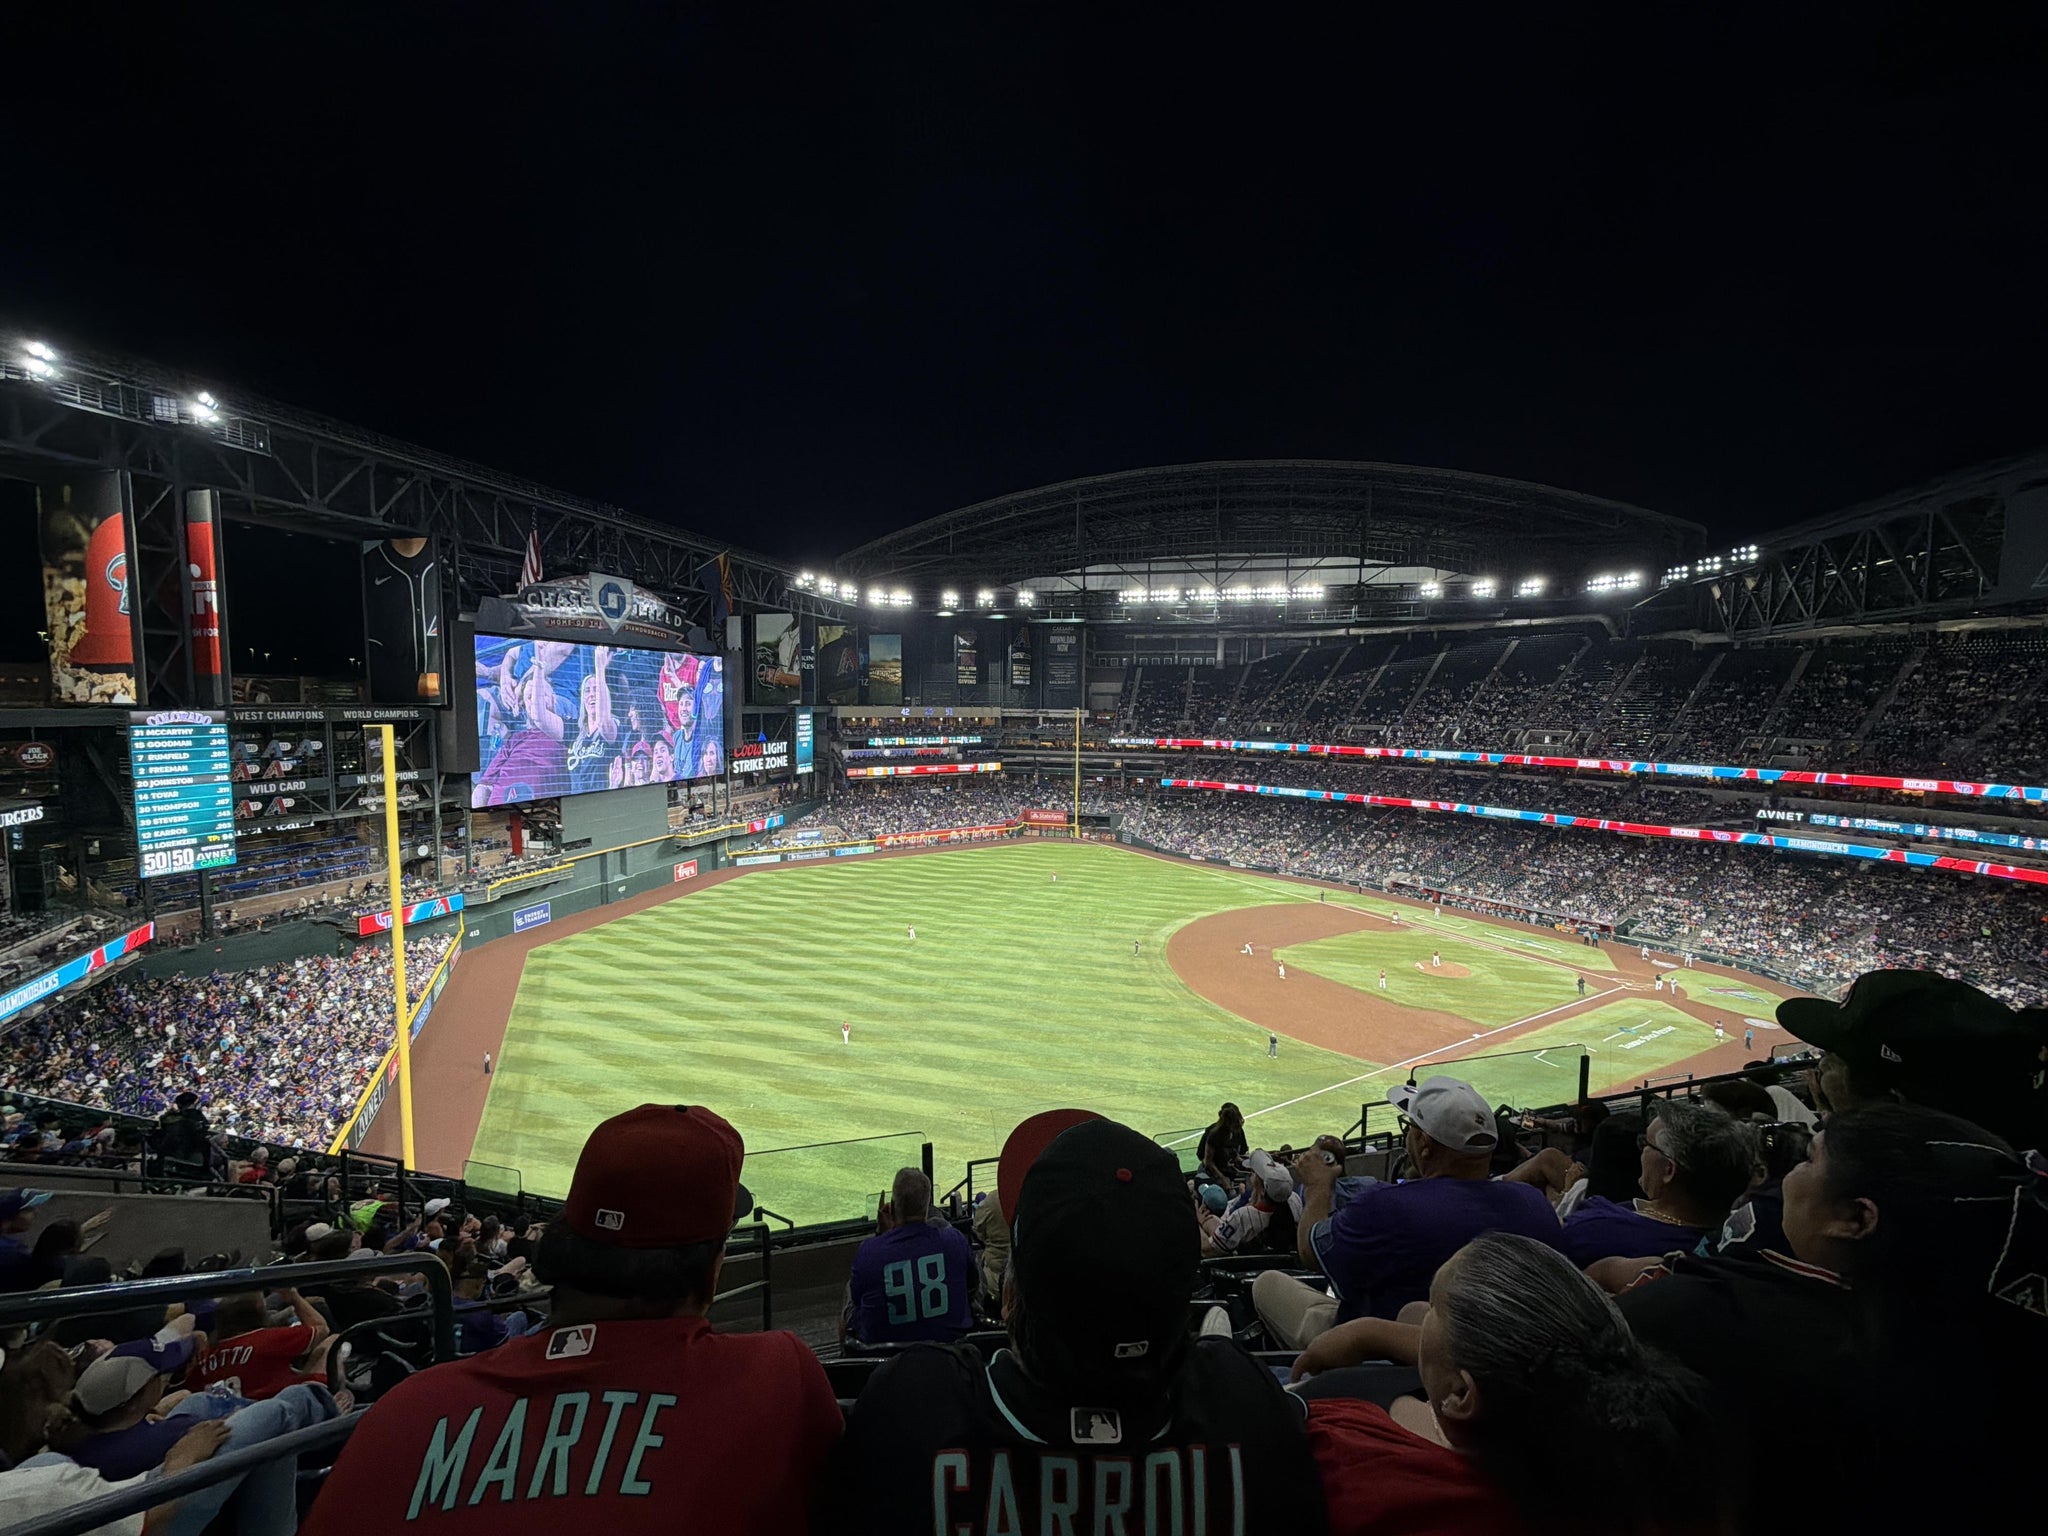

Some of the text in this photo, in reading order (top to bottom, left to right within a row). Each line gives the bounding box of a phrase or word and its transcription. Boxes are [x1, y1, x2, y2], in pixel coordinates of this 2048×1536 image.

[526, 589, 592, 609] CHASE
[625, 624, 668, 639] DIAMONDBACKS
[234, 711, 324, 720] WEST CHAMPIONS
[343, 710, 419, 719] WORLD CHAMPIONS
[901, 707, 910, 716] 42
[146, 711, 212, 726] COLORADO
[147, 740, 193, 748] GOODMAN
[763, 741, 788, 755] LIGHT
[21, 752, 49, 760] BLACK
[148, 752, 190, 761] RUMFIELD
[148, 765, 189, 774] FREEMAN
[732, 757, 764, 774] STRIKE
[765, 755, 788, 770] ZONE
[149, 777, 194, 788] JOHNSTON
[357, 771, 419, 785] NL CHAPIONS
[249, 780, 306, 795] WILD CARD
[150, 791, 179, 799] TOVAR
[152, 801, 200, 812] THOMPSON
[153, 815, 189, 825] STEVENS
[1756, 809, 1804, 822] AVNET
[1787, 838, 1850, 854] DIAMONDBACKS
[196, 848, 235, 861] AVNET
[200, 855, 231, 867] CARES
[524, 909, 545, 919] ENERGY
[525, 912, 549, 923] TRANSFER
[469, 929, 480, 937] 413
[358, 1081, 384, 1139] AVNET
[883, 1253, 949, 1326] 98
[405, 1390, 677, 1522] MARTE
